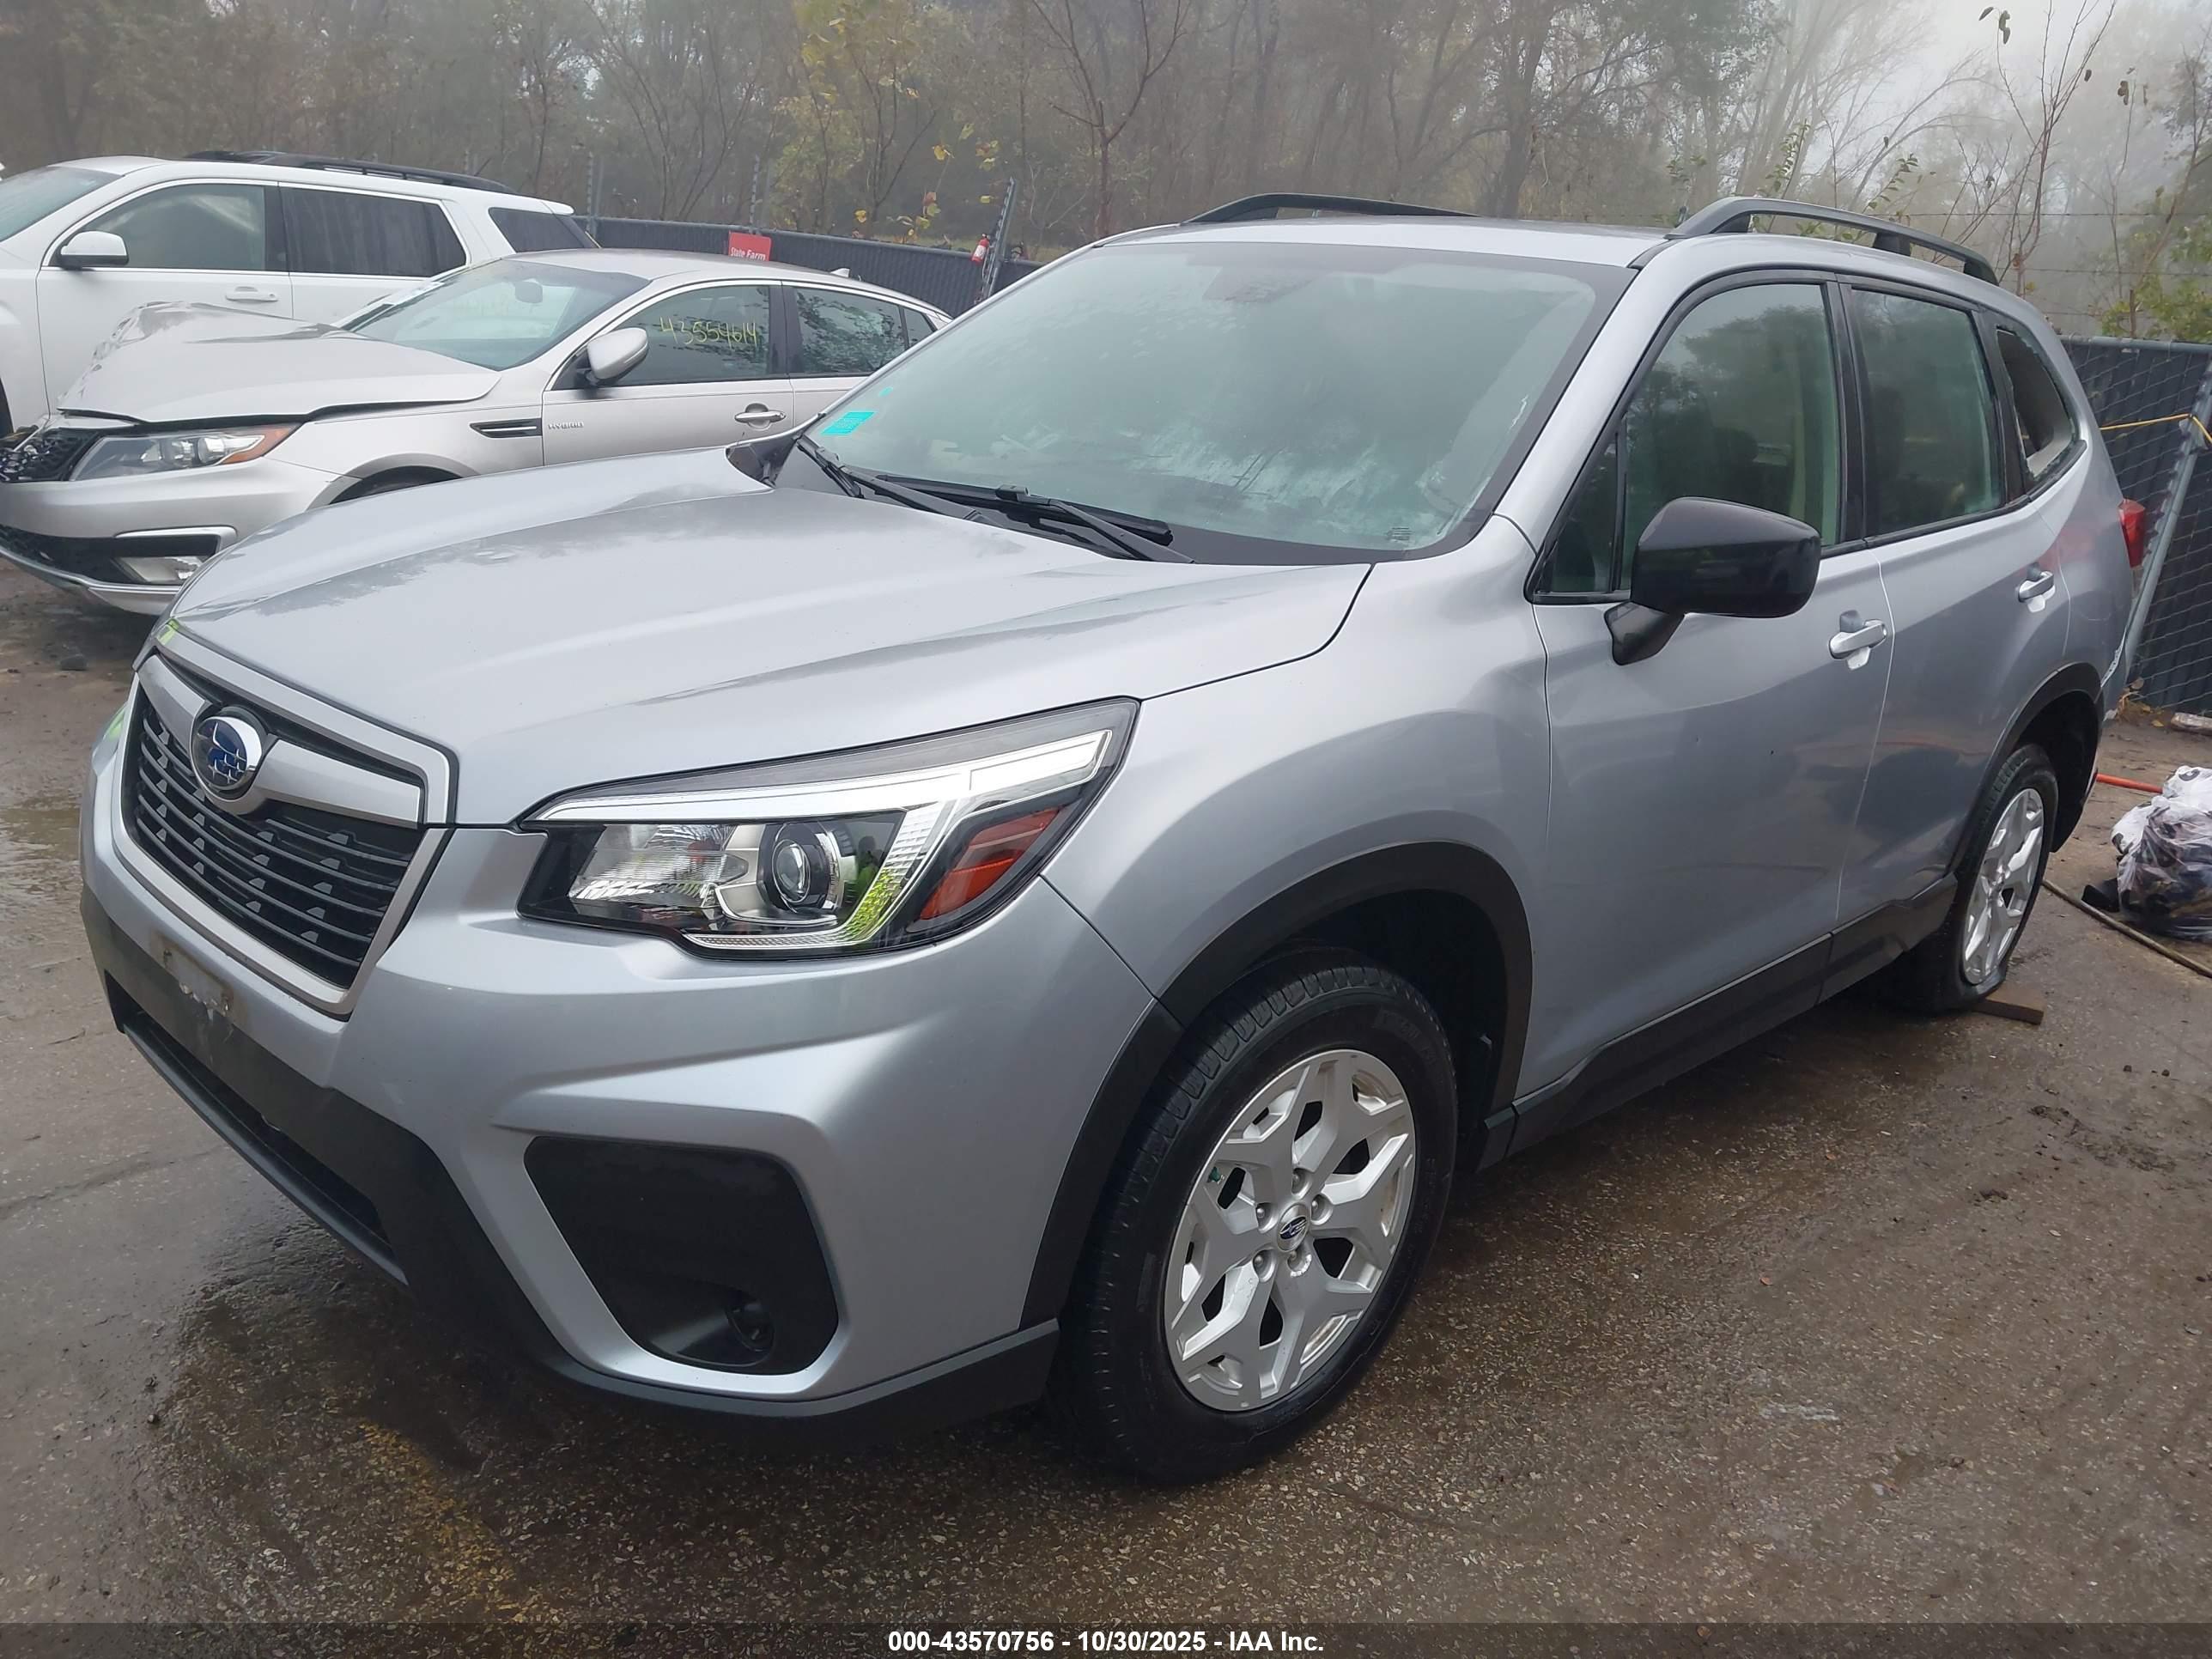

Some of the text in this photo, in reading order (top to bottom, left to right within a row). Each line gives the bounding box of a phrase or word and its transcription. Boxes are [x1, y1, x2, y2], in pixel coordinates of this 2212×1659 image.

[731, 246, 766, 261] State Farm
[548, 421, 585, 430] HYBRID
